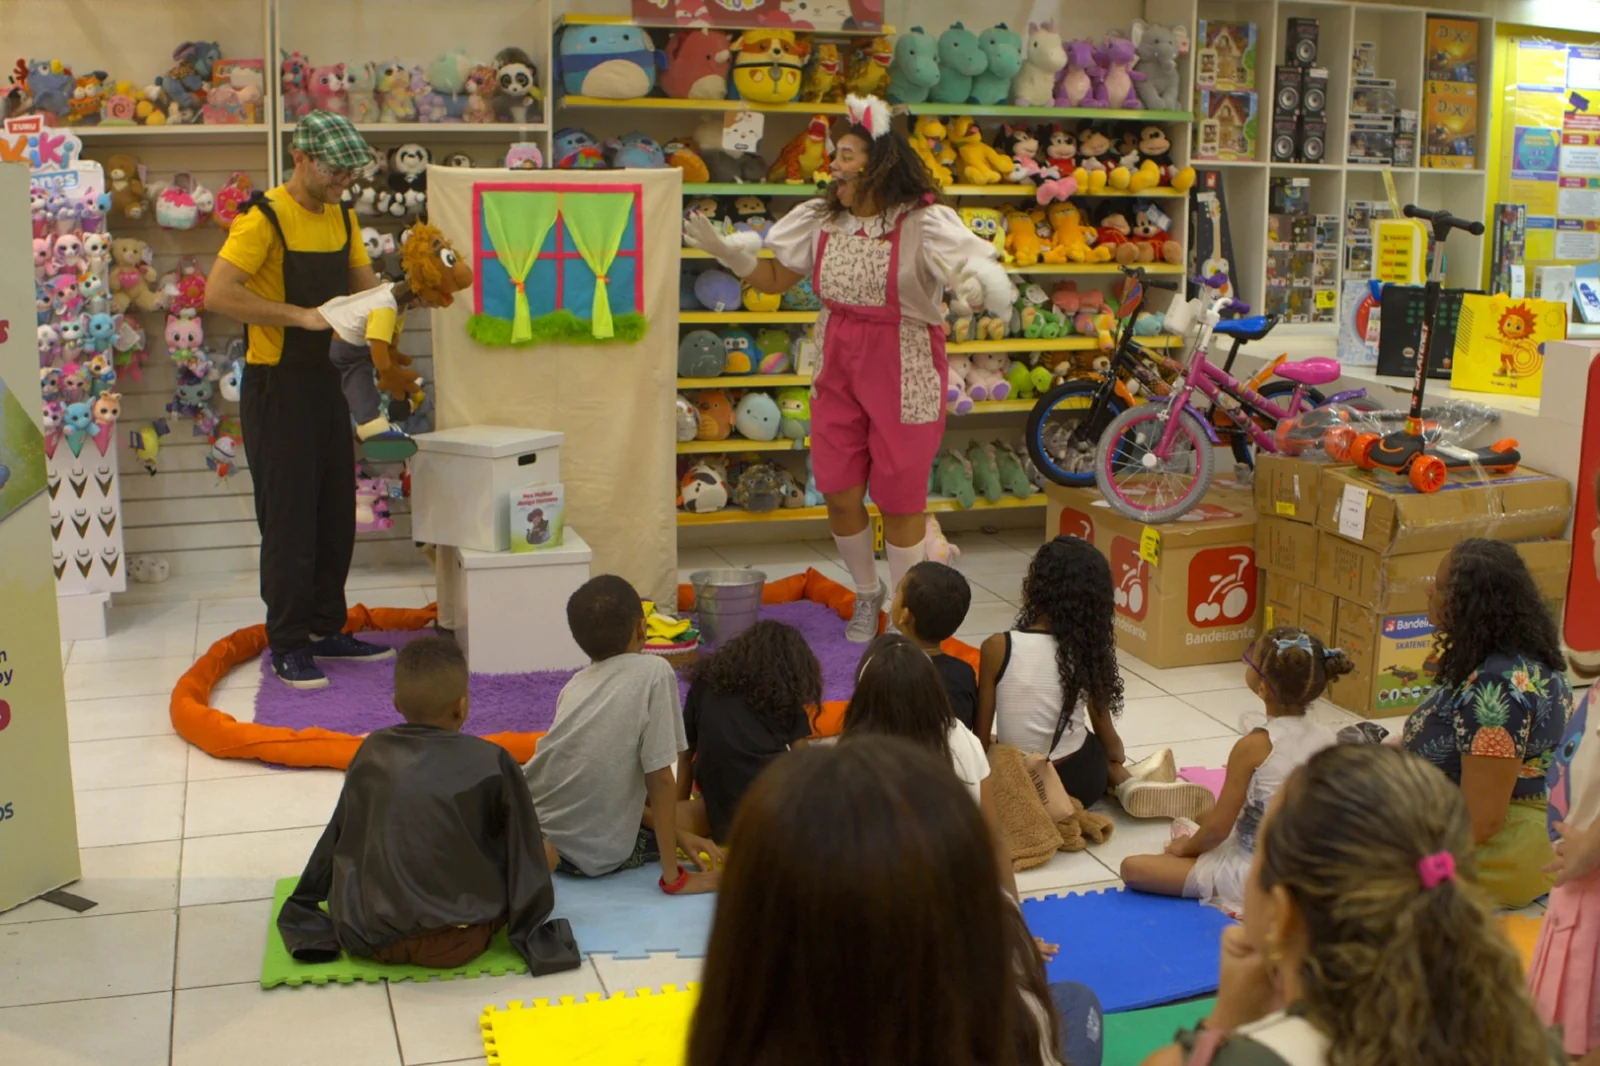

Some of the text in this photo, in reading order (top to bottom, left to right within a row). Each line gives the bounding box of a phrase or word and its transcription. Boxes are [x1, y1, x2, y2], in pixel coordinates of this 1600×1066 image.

[12, 123, 36, 131] ZURU
[1111, 616, 1148, 641] ndeirante
[1397, 618, 1432, 630] Bandei
[1185, 627, 1256, 646] Bandeirante
